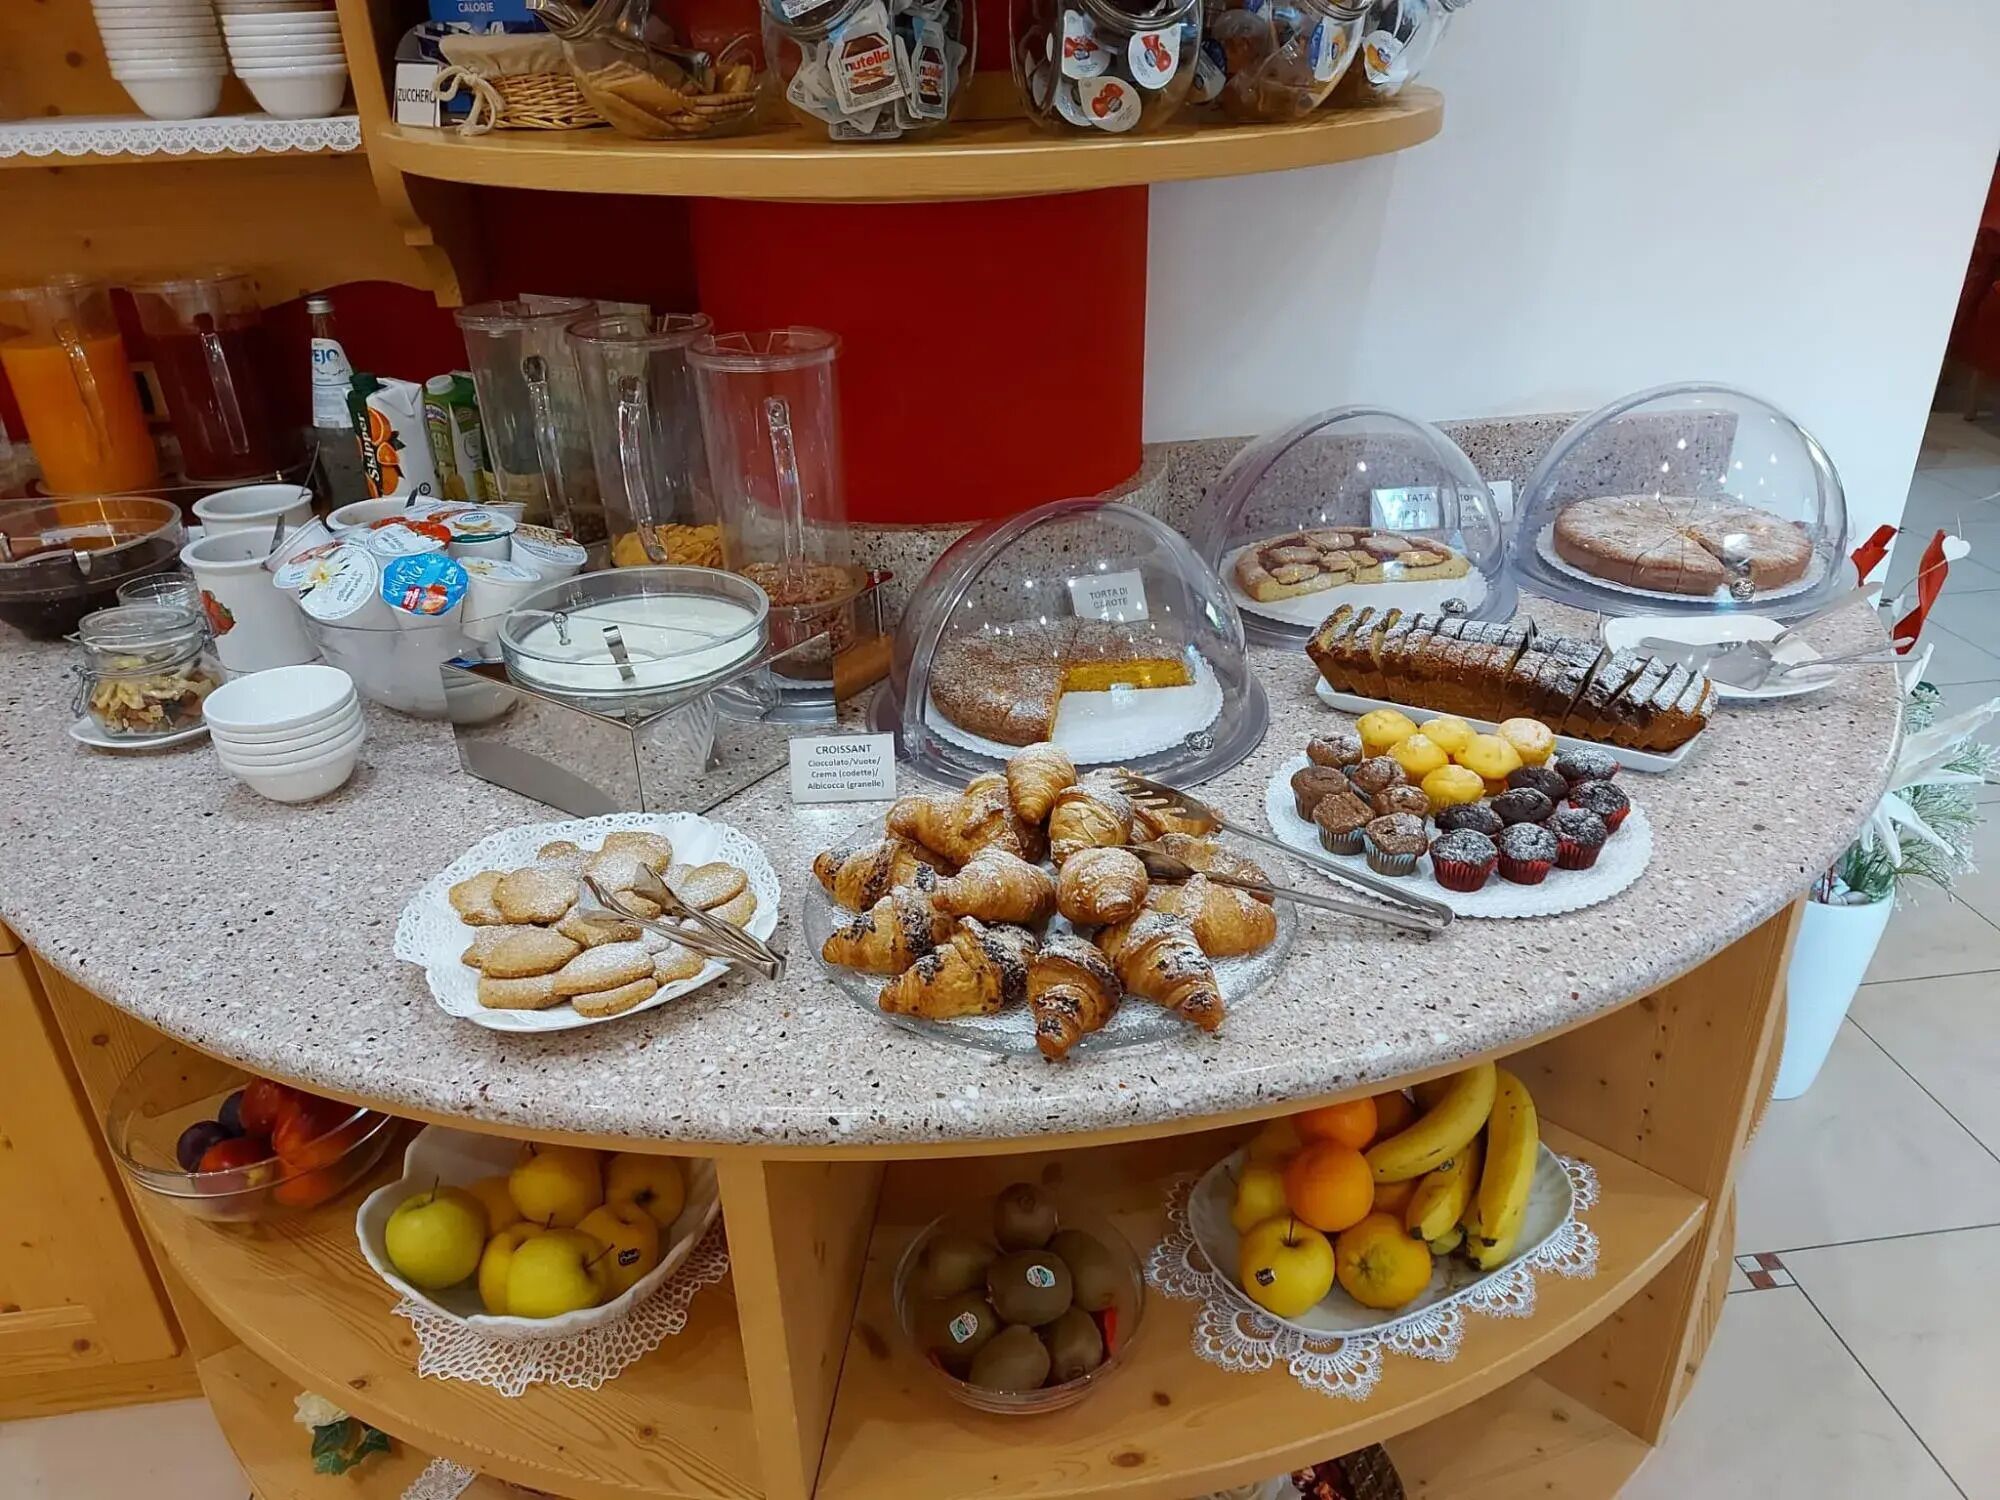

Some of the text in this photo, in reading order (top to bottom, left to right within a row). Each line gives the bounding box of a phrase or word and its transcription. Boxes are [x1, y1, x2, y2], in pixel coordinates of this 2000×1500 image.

[458, 3, 494, 12] CALORIE
[845, 50, 890, 72] nutella
[312, 348, 340, 365] EJO
[357, 412, 380, 482] Skipper
[1089, 586, 1128, 600] TORTA DI
[816, 744, 872, 755] CROISSANT
[811, 770, 837, 778] Crema
[807, 781, 845, 790] Albicocca
